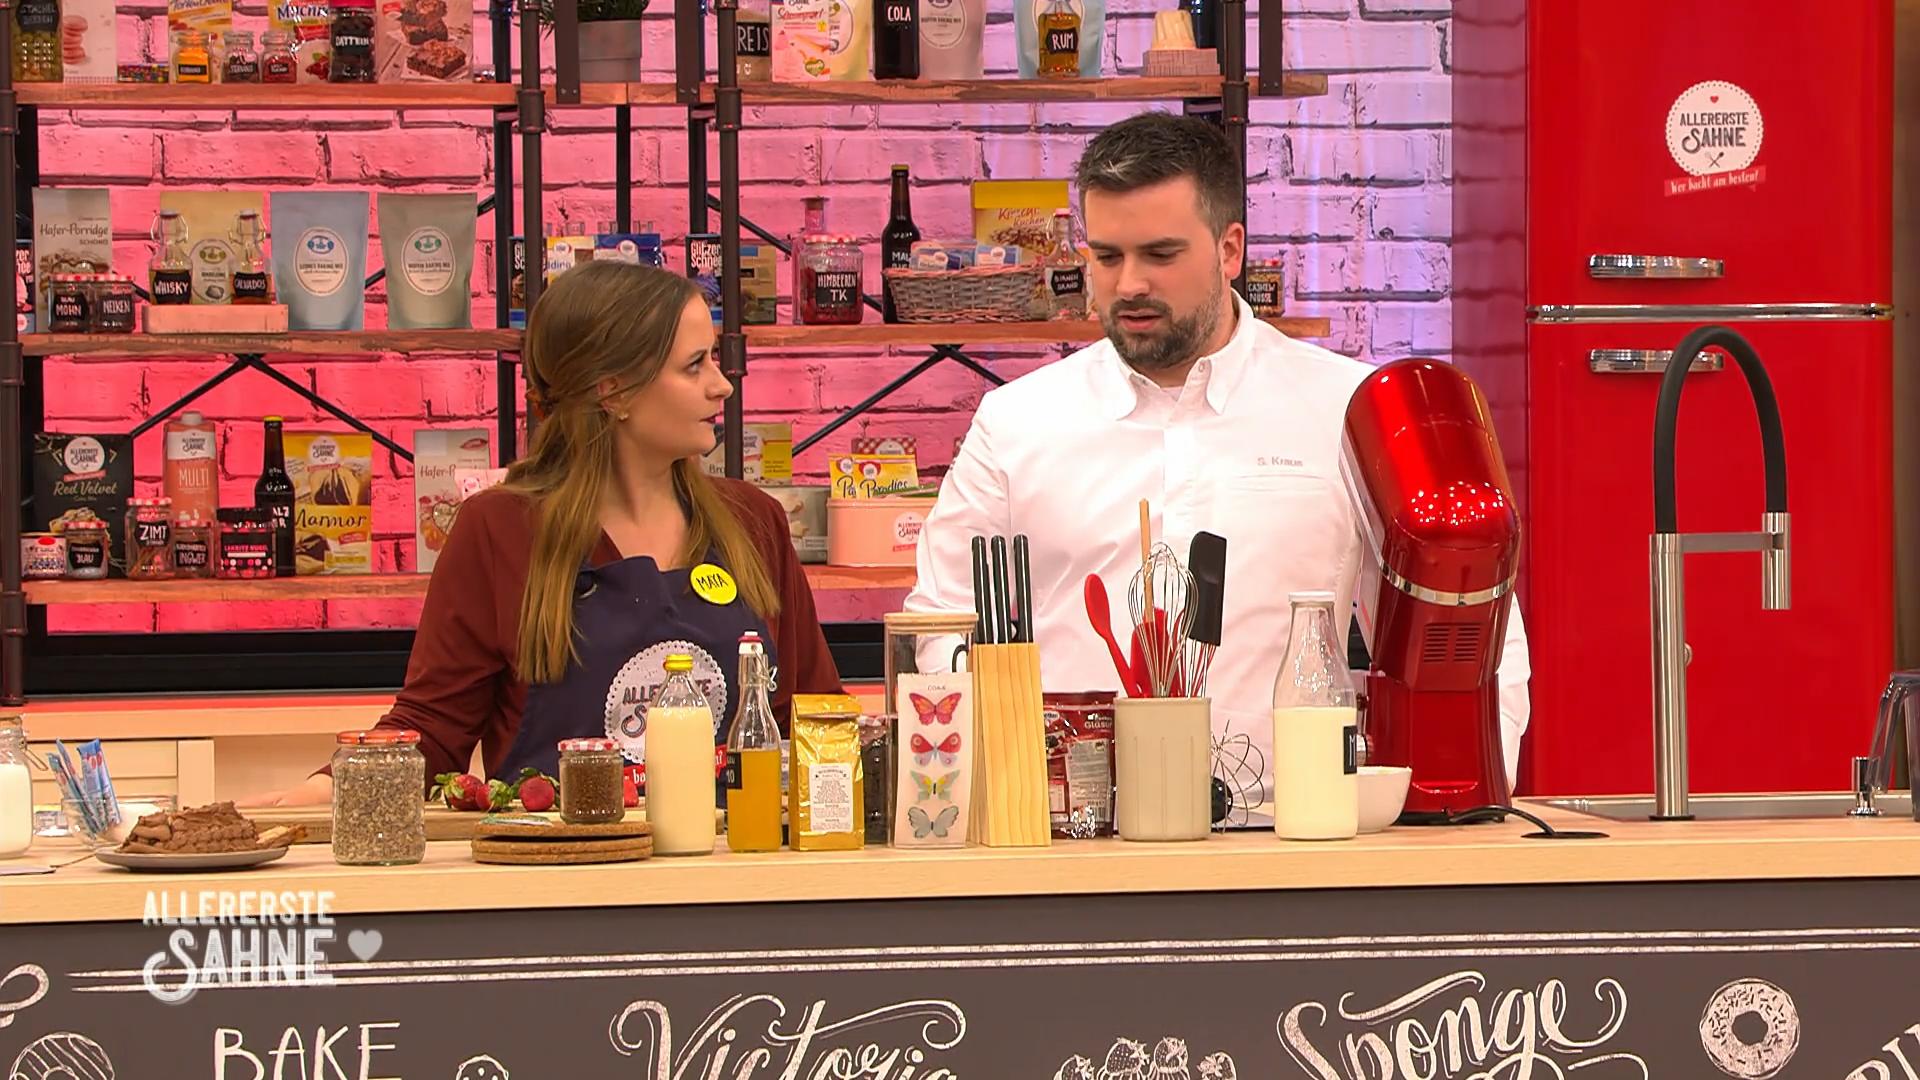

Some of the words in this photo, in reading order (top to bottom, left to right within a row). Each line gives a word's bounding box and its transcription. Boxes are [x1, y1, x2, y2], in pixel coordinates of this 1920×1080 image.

[887, 6, 912, 22] COLA
[737, 25, 770, 52] REIS
[1052, 33, 1075, 50] RUM
[1679, 111, 1749, 127] ALLERERSTE
[1681, 127, 1747, 155] SAHNE
[1670, 180, 1687, 195] Wer
[1688, 177, 1712, 192] backt
[1713, 175, 1726, 187] am
[40, 222, 109, 238] Hafer-Porridge
[690, 241, 721, 256] Glitzer
[892, 251, 911, 261] MAL
[153, 280, 189, 296] WHISKY
[234, 279, 266, 290] CALVADOS
[817, 274, 857, 288] HIMBEEREN
[1248, 283, 1275, 292] CASHEW
[830, 288, 848, 302] TK
[56, 304, 82, 316] MOHN
[103, 300, 131, 313] NELKEN
[178, 468, 209, 488] MULTI
[53, 481, 79, 496] Red
[80, 481, 117, 495] Velvet
[139, 524, 168, 541] ZIMT
[695, 573, 729, 592] MAYA
[213, 1021, 402, 1080] BAKE
